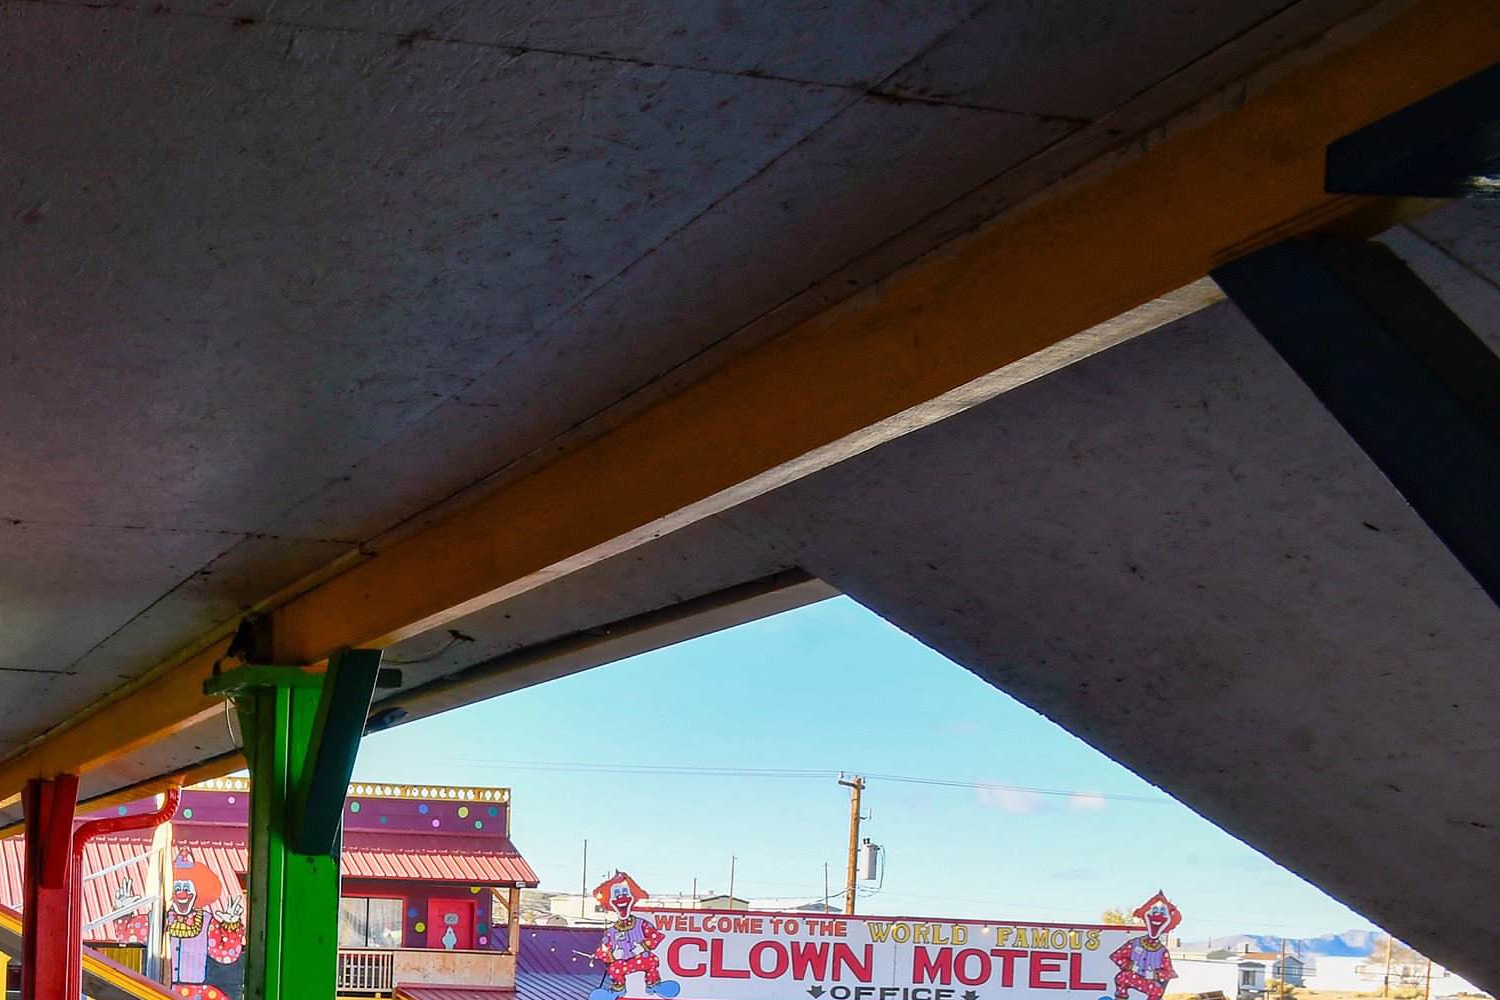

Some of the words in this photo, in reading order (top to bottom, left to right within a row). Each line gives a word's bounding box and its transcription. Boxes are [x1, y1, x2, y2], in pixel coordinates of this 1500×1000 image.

[655, 914, 764, 934] WELCOME
[770, 918, 799, 935] TO
[806, 920, 847, 937] THE
[867, 921, 968, 945] WORLD
[995, 926, 1101, 951] FAMOUS
[667, 936, 873, 983] CLOWN
[912, 945, 1107, 990] MOTEL
